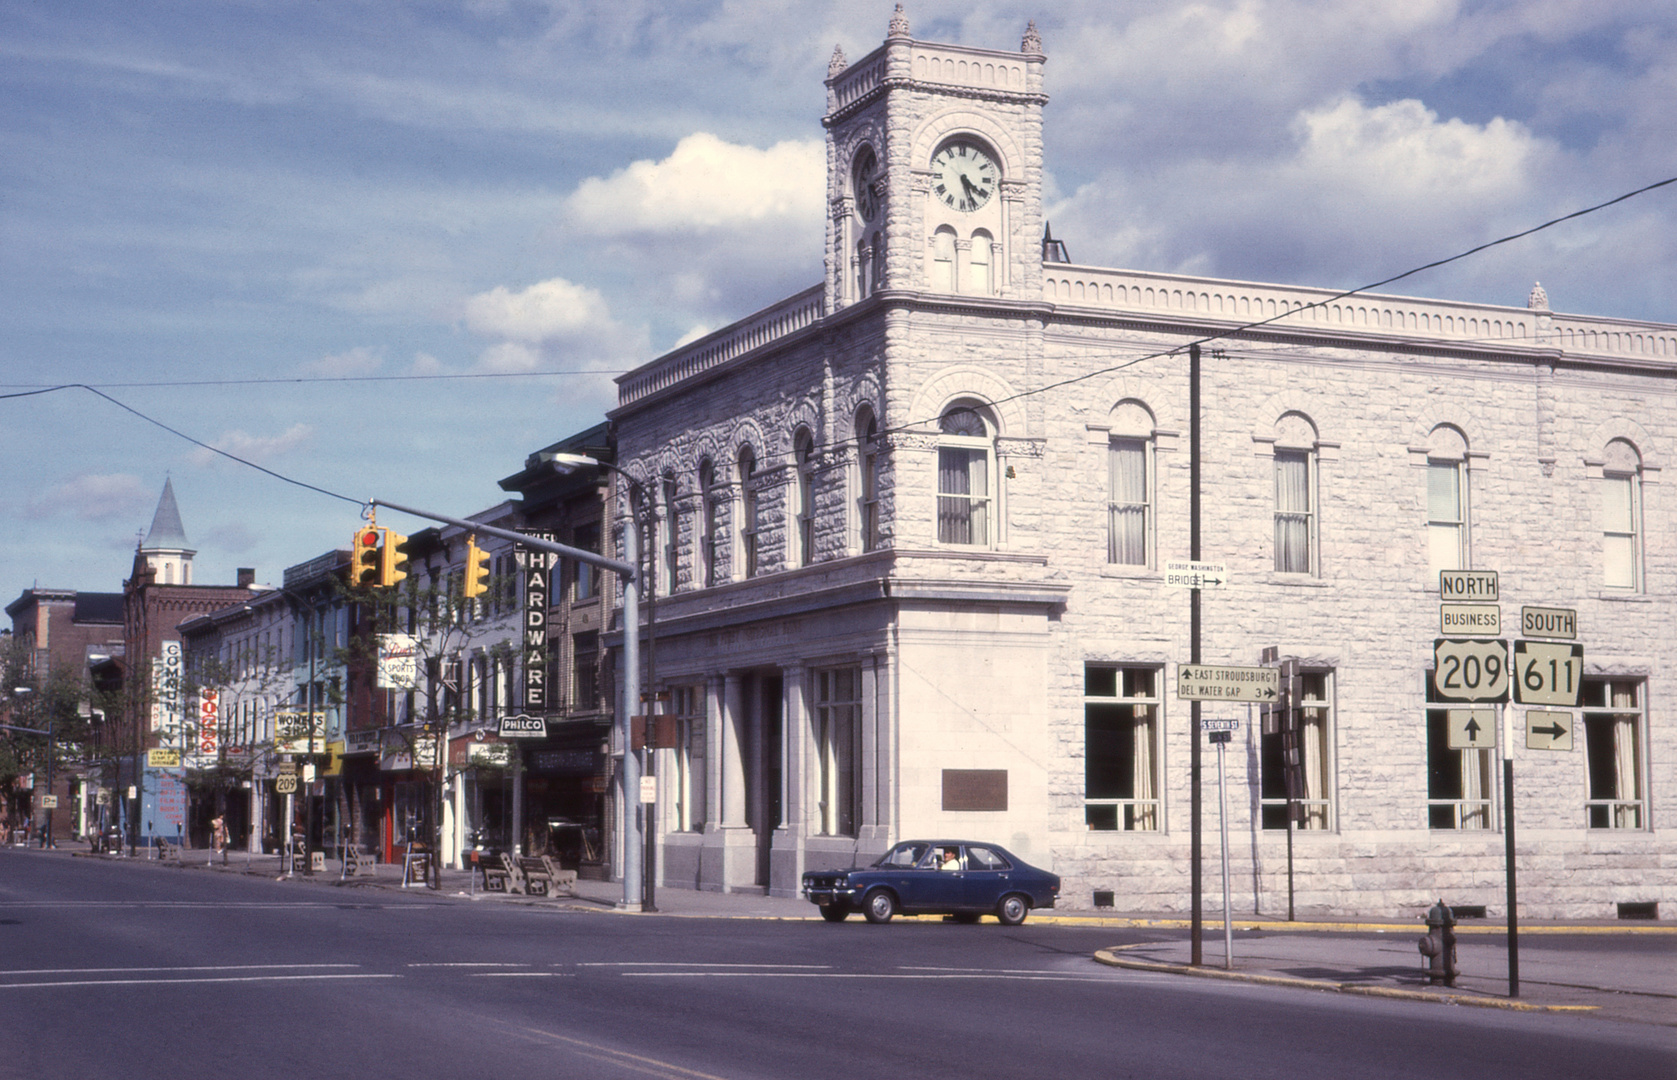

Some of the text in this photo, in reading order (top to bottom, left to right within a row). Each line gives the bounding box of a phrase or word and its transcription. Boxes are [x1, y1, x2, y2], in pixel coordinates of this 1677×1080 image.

[1168, 563, 1224, 572] GEORGE WASHINGTON
[1168, 574, 1201, 586] BRIDGE
[1443, 577, 1496, 595] NORTH
[1444, 613, 1497, 626] BUSINESS
[1525, 613, 1573, 633] SOUTH
[527, 553, 545, 704] HARDWARE
[388, 664, 414, 673] SPORTS
[1443, 654, 1501, 689] 209
[1194, 669, 1277, 683] EAST STROUDSBURG 1
[1524, 658, 1572, 693] 611
[165, 645, 179, 745] COMMUNITY
[1198, 685, 1223, 696] WATER
[1225, 686, 1241, 697] GAP
[1255, 688, 1262, 698] 3
[278, 715, 324, 726] WOME'S
[504, 720, 542, 730] PHILCO
[284, 726, 312, 736] SHO
[278, 779, 296, 790] 209
